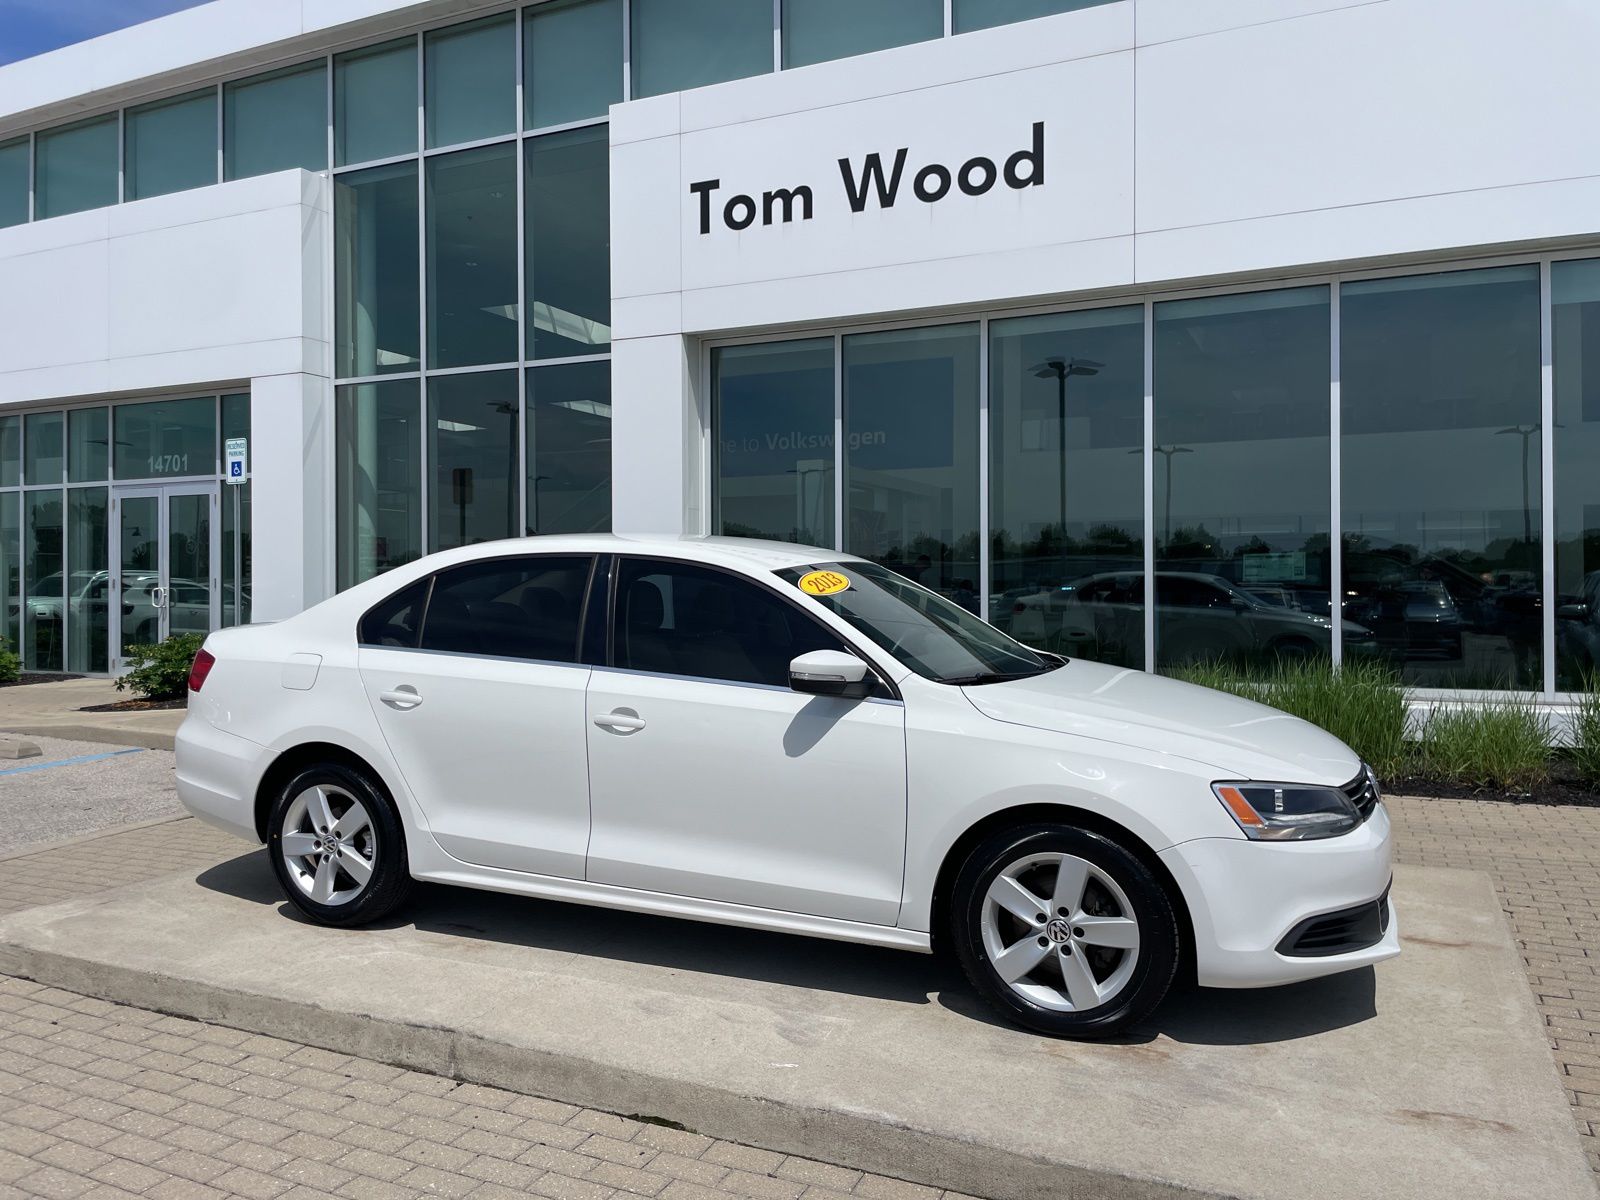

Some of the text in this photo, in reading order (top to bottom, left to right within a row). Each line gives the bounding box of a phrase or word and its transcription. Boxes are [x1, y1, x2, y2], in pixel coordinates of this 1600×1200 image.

[690, 121, 1045, 235] Tom Wood
[742, 437, 760, 452] to
[765, 430, 886, 451] Volkswgen
[147, 453, 188, 473] 14701
[808, 573, 842, 592] 2013
